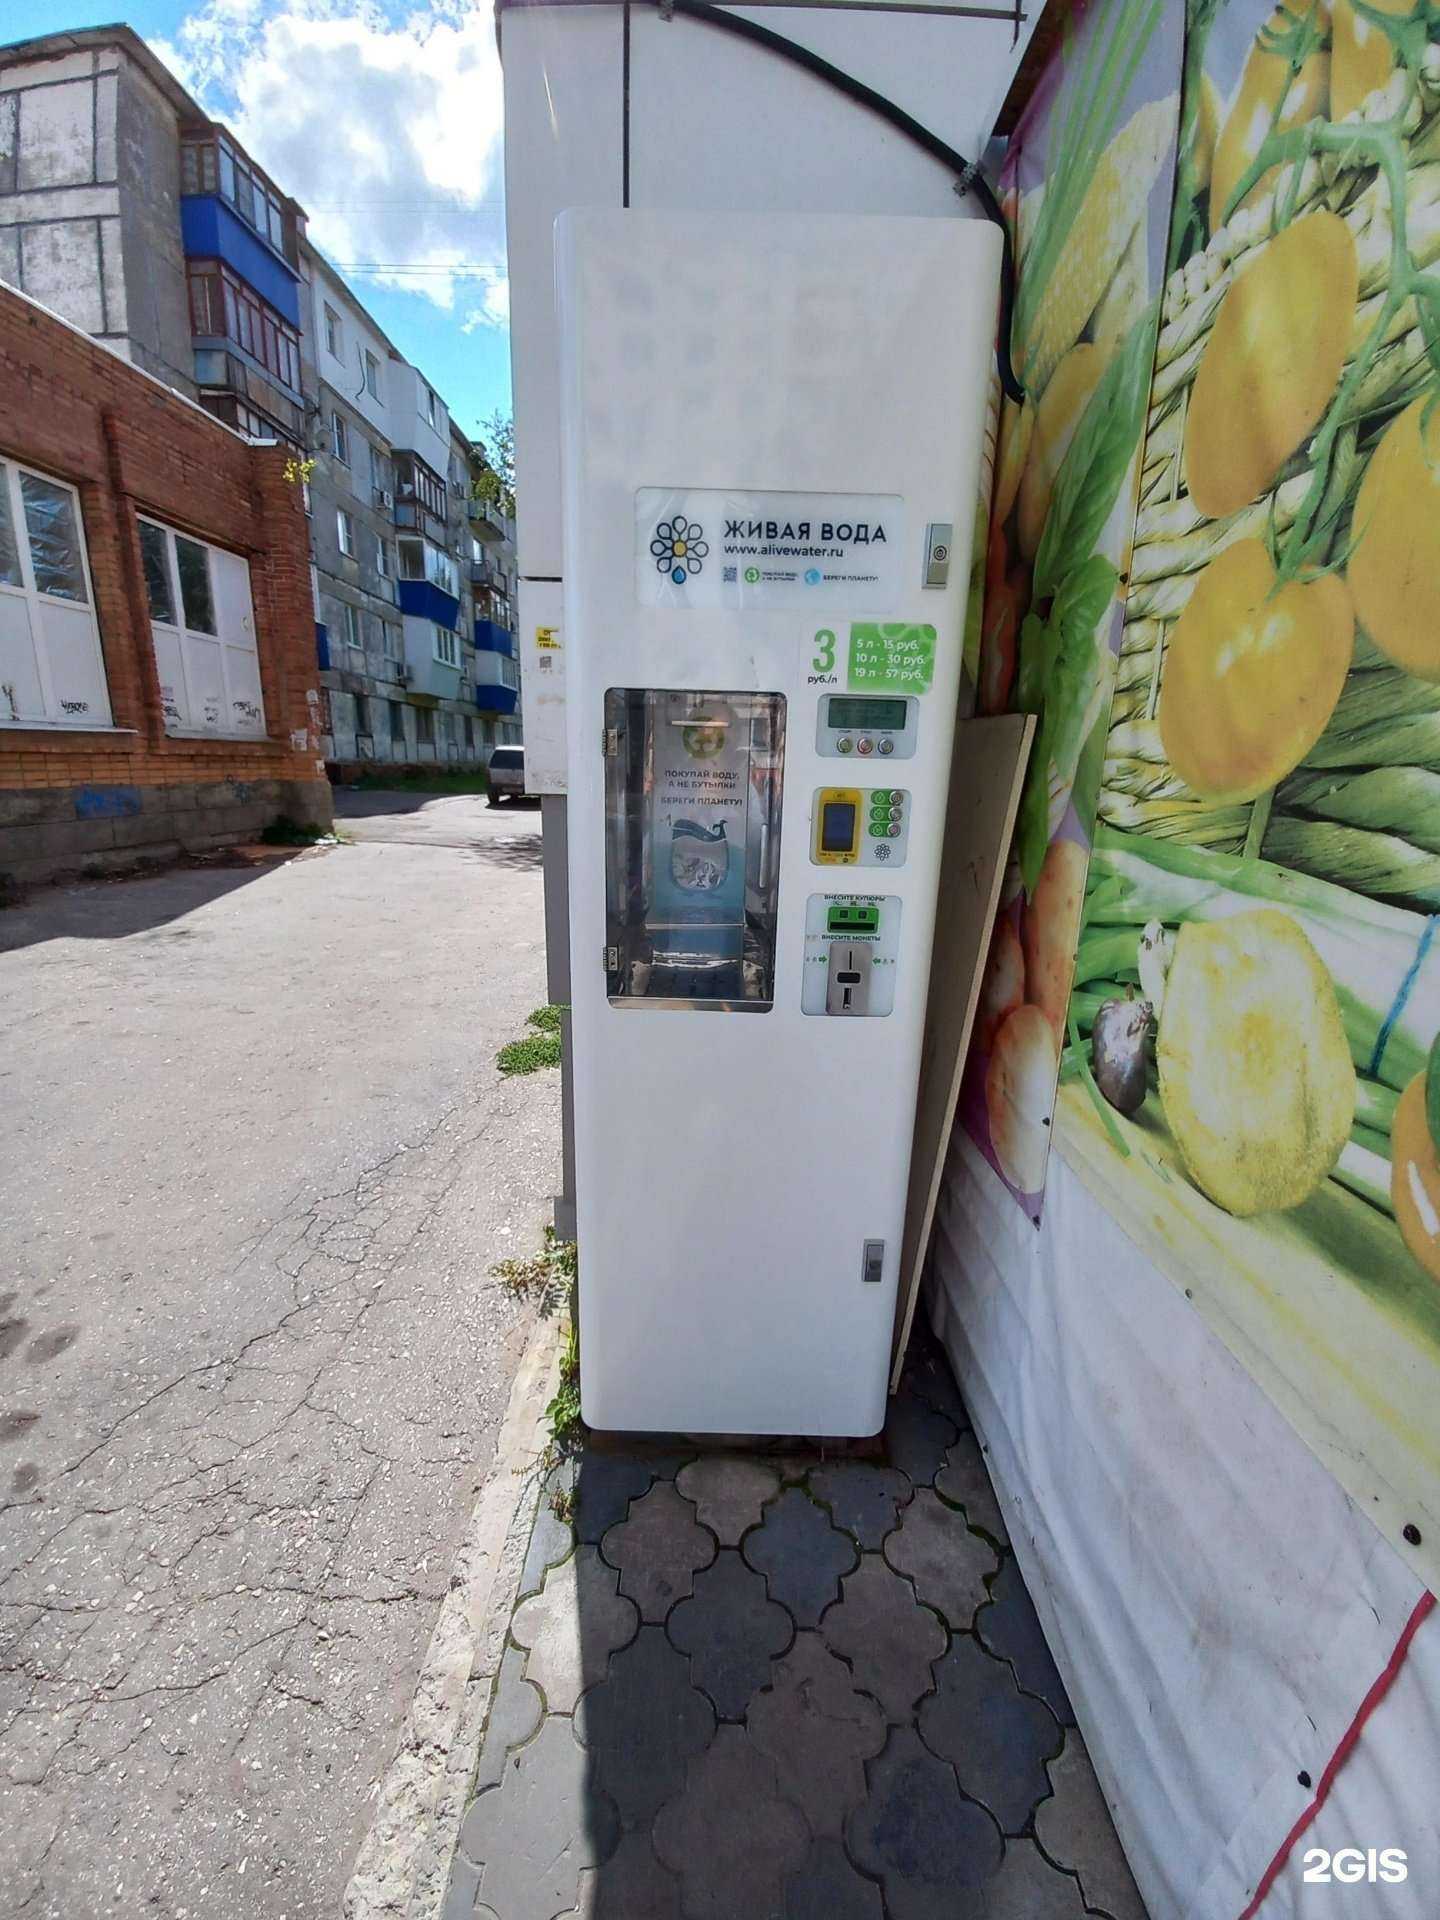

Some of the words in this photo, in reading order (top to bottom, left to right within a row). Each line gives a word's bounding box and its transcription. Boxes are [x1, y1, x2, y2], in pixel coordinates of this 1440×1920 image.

[723, 520, 811, 540] ЖИВАЯ
[821, 522, 887, 544] ВОДА
[724, 544, 844, 557] www.alivewater.ru
[812, 629, 836, 673] 3
[857, 639, 864, 648] 5
[866, 640, 874, 648] л
[883, 640, 894, 649] 15
[897, 639, 919, 652] руб.
[856, 653, 867, 662] 10
[870, 655, 878, 663] л
[887, 654, 900, 664] 30
[903, 655, 926, 666] руб.
[807, 674, 838, 685] руб./л
[855, 667, 866, 677] 19
[868, 669, 876, 677] л
[885, 669, 898, 678] 57
[901, 669, 923, 681] руб.
[665, 769, 710, 778] ПОКУПАЙ
[668, 780, 674, 788] А
[677, 780, 689, 788] НЕ
[692, 781, 736, 789] БУТЫЛКИ
[660, 797, 695, 805] БЕРЕГИ
